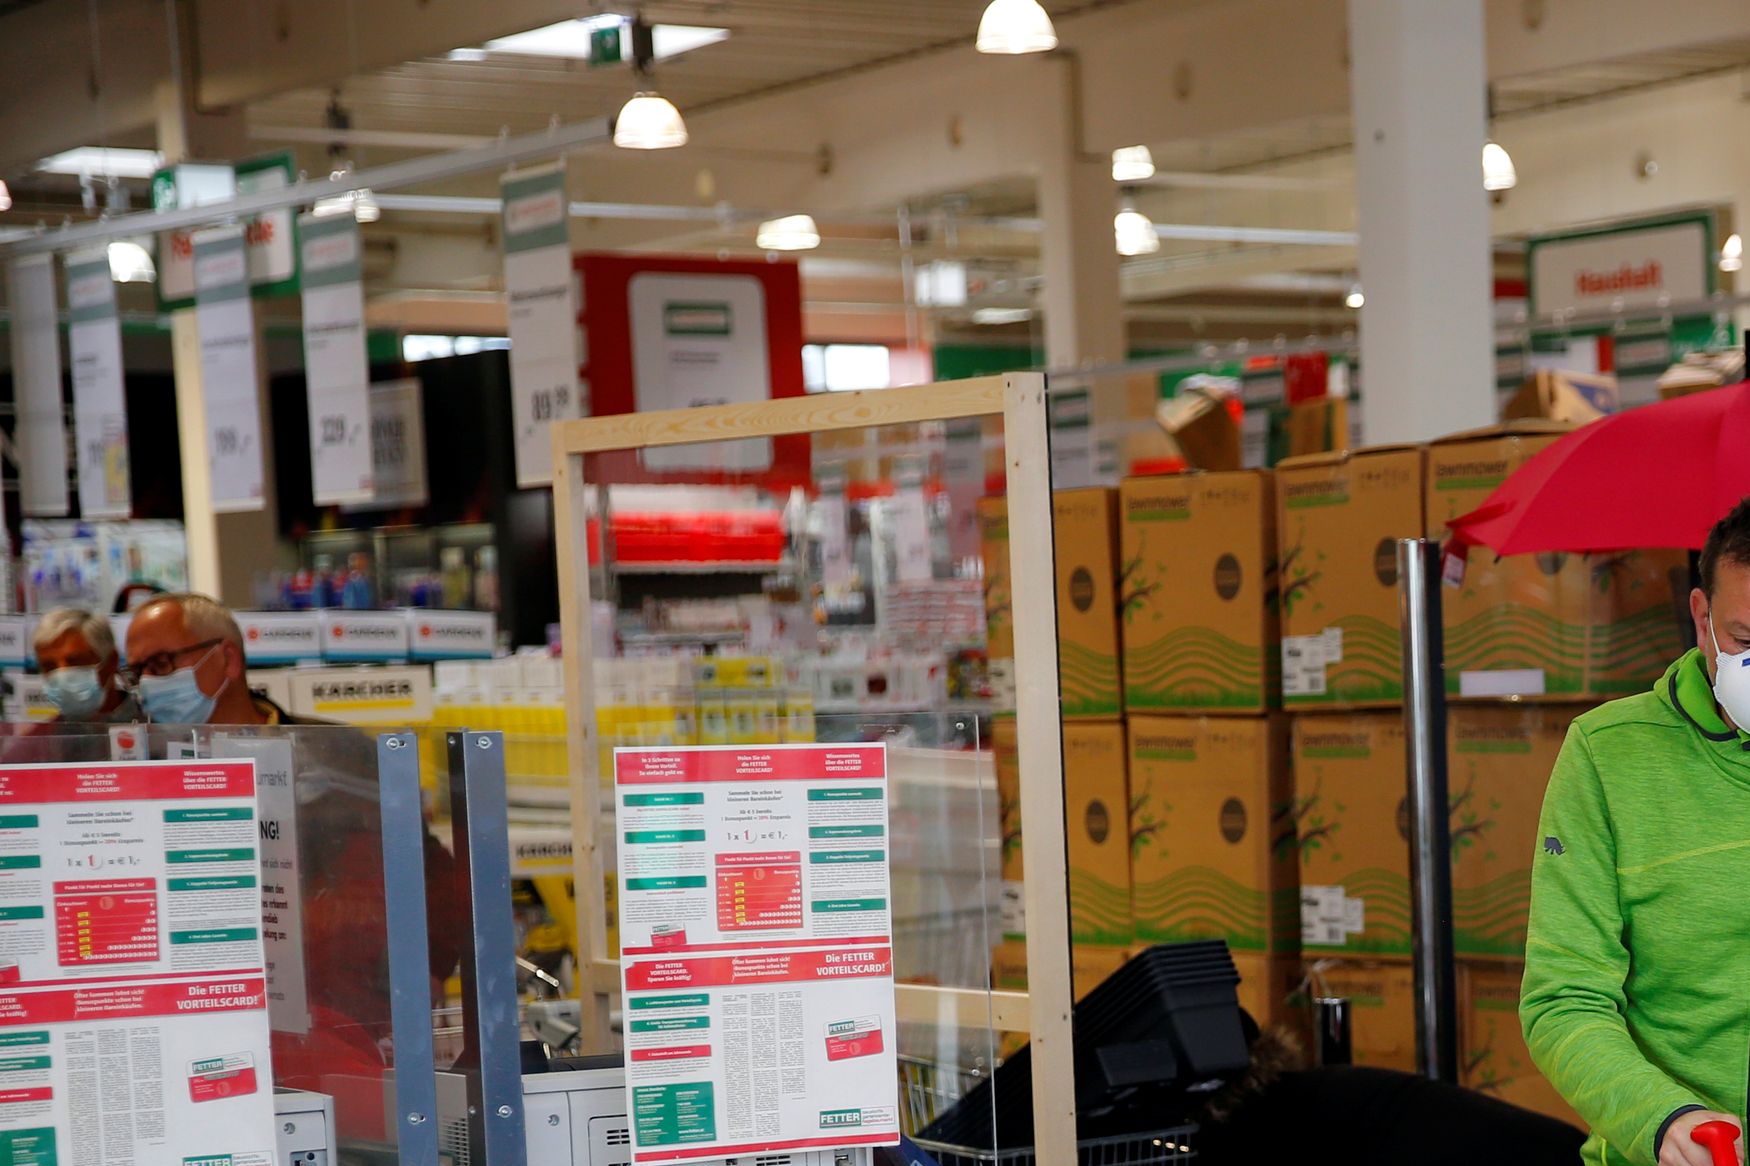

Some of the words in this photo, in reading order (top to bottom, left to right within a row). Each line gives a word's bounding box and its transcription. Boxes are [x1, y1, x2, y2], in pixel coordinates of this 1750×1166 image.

[825, 953, 841, 963] Die
[842, 952, 875, 962] FETTER
[816, 963, 886, 976] VORTEILSCARD!
[188, 985, 206, 996] Die
[208, 983, 246, 995] FETTER
[176, 995, 258, 1010] VORTEILSCARD!
[829, 1022, 855, 1033] FETTER
[820, 1112, 860, 1124] FETTER
